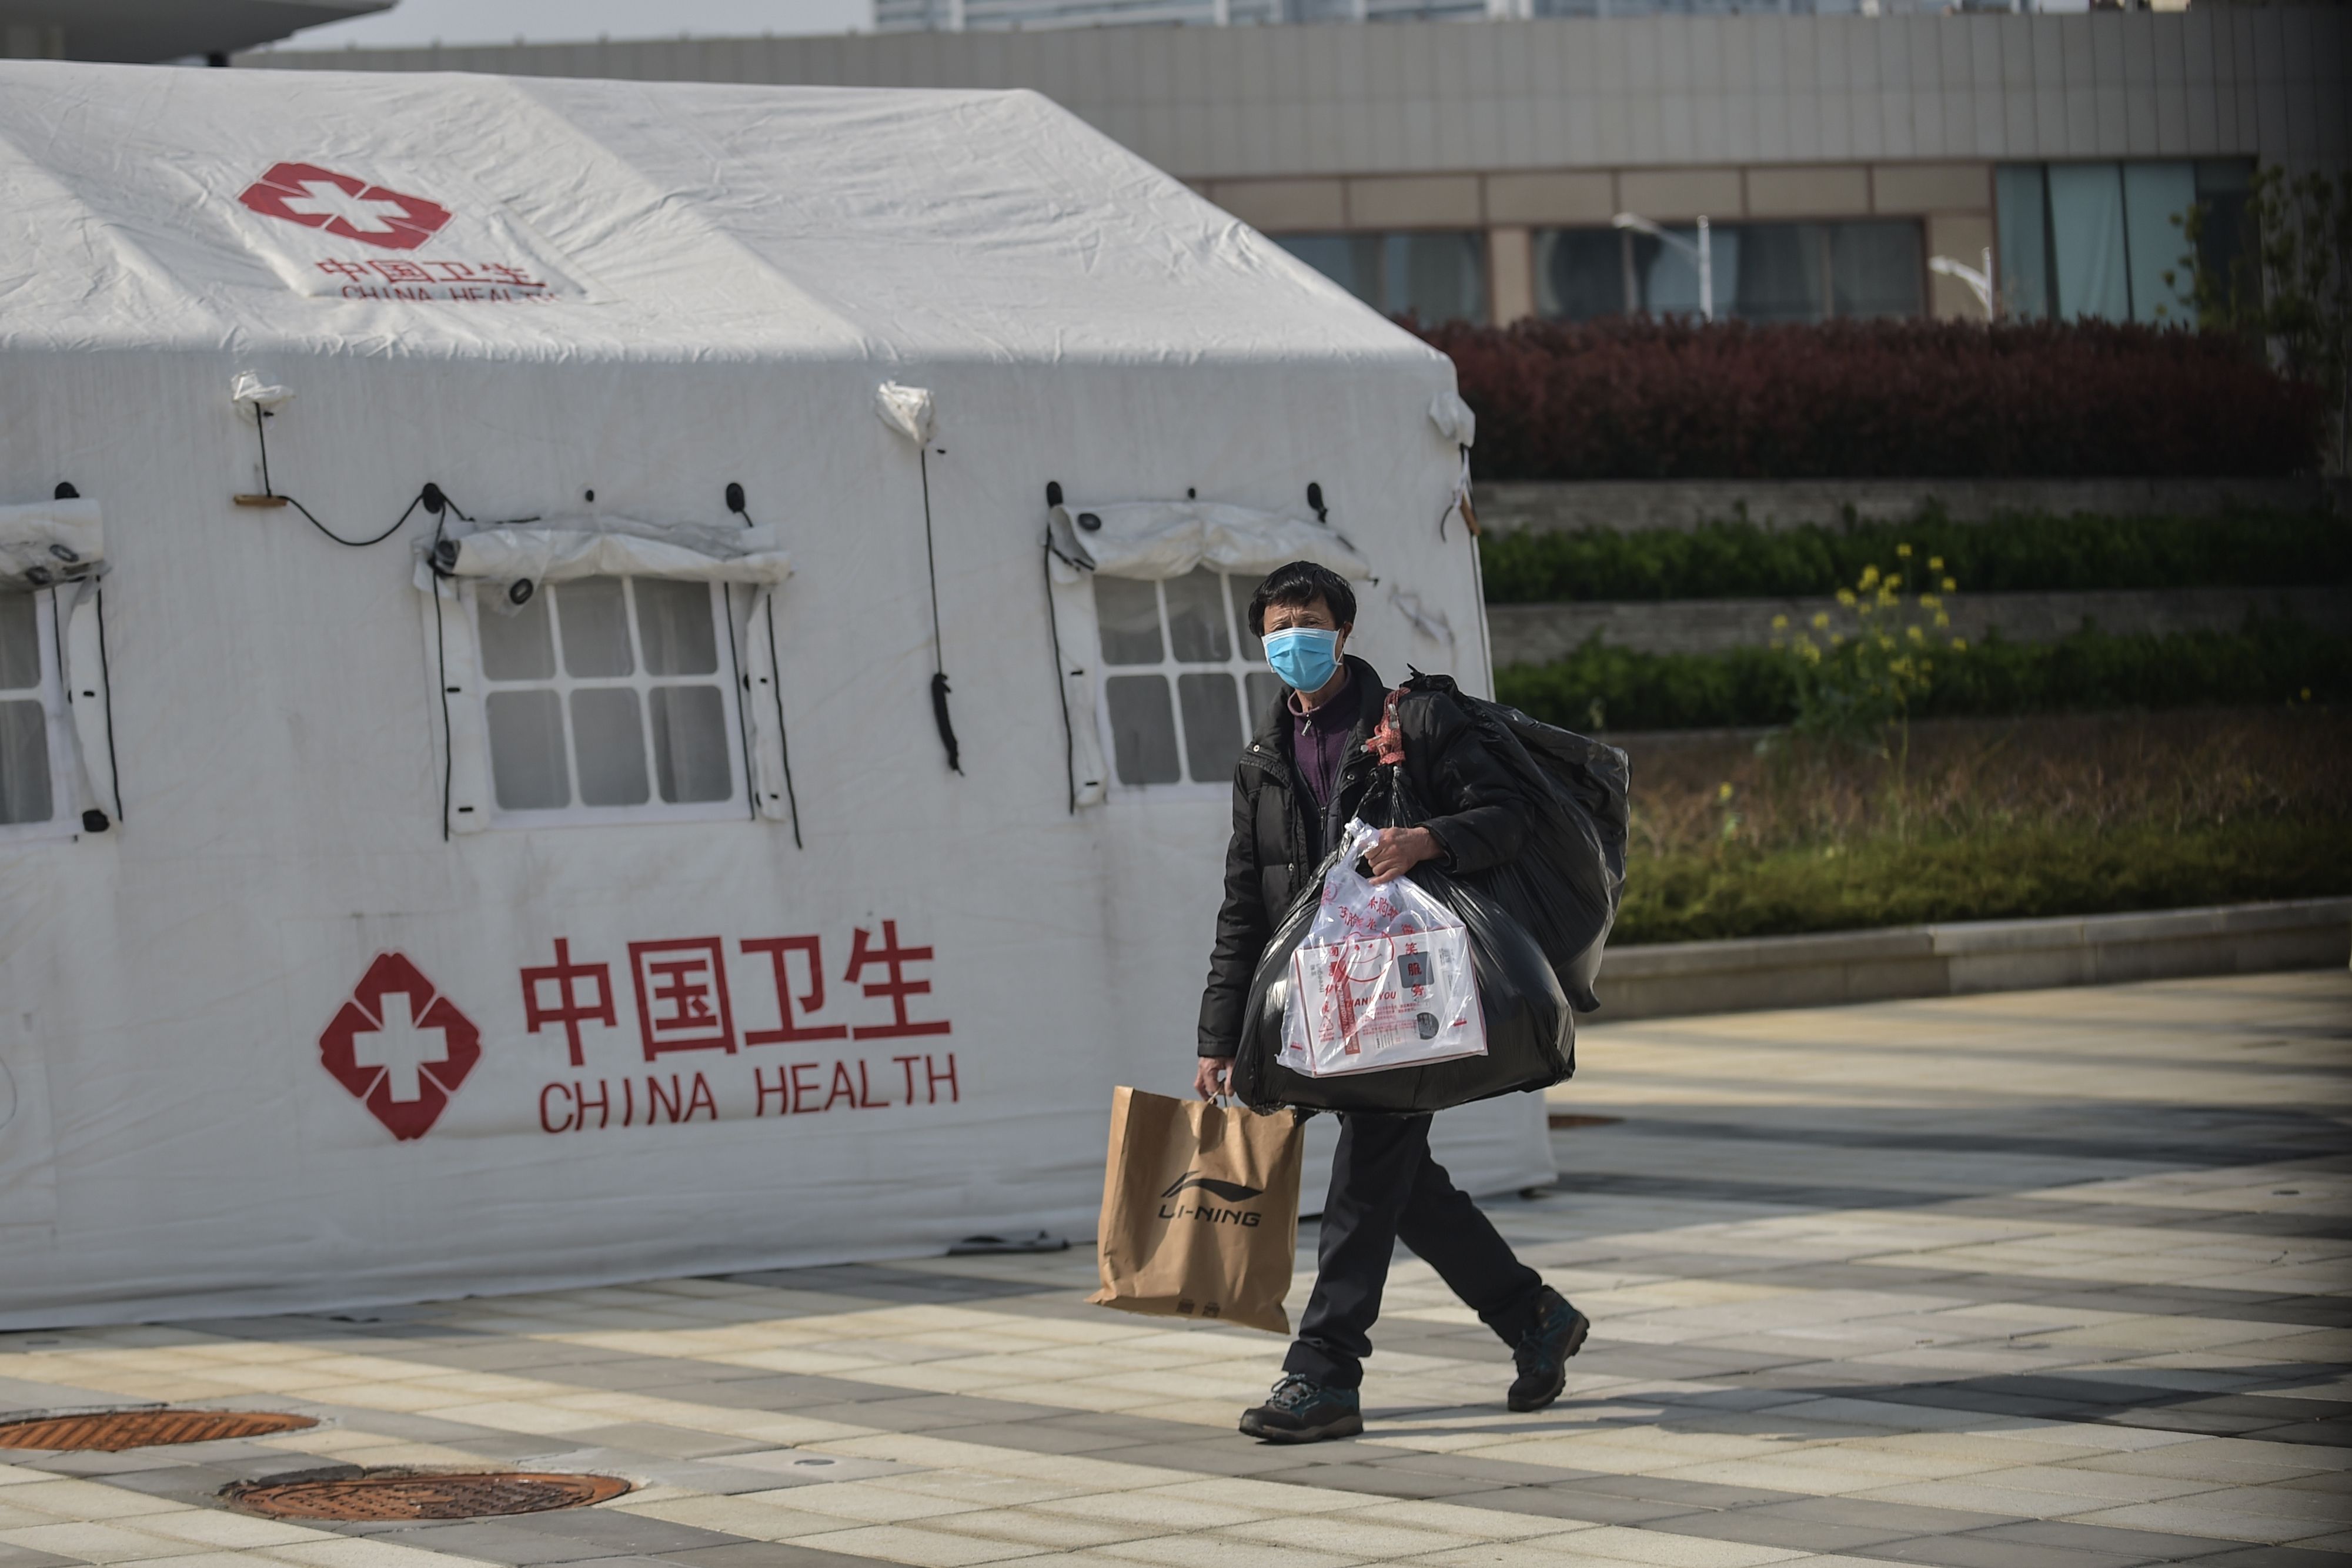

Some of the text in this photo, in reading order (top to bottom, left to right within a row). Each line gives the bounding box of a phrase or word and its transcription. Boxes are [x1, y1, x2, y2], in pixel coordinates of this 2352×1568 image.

[315, 258, 547, 289] 中国卫生
[342, 285, 432, 302] CHINA
[520, 920, 951, 1066] 中国卫生
[1379, 991, 1397, 1001] YOU
[539, 1054, 959, 1135] CHINA HEALTH
[1158, 1204, 1262, 1228] LI-NING
